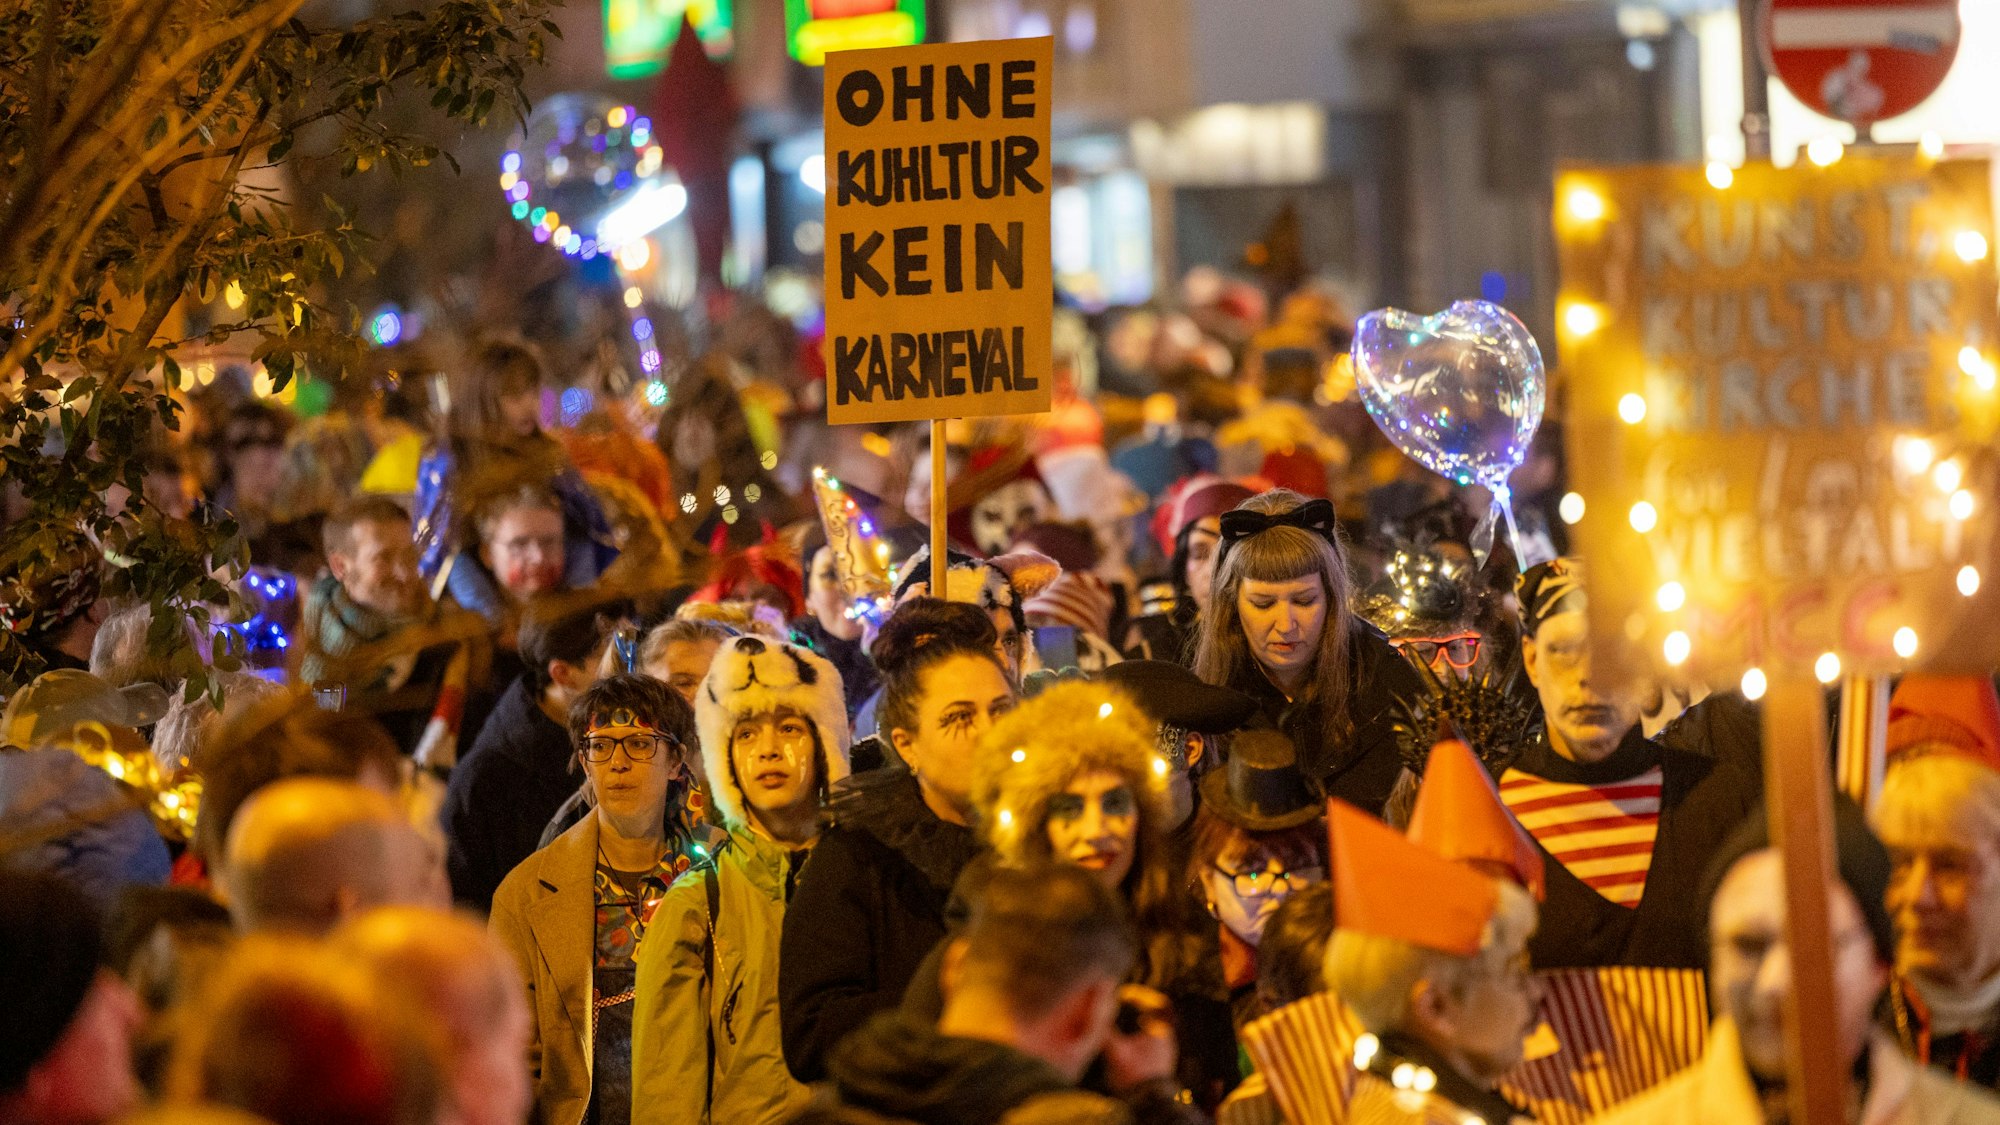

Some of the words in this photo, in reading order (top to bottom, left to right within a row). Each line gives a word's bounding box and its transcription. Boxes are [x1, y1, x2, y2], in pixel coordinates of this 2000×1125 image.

[836, 60, 1036, 127] OHNE
[837, 135, 1044, 207] KUHLTUR
[840, 222, 1024, 299] KEIN
[834, 326, 1039, 405] KARNEVAL
